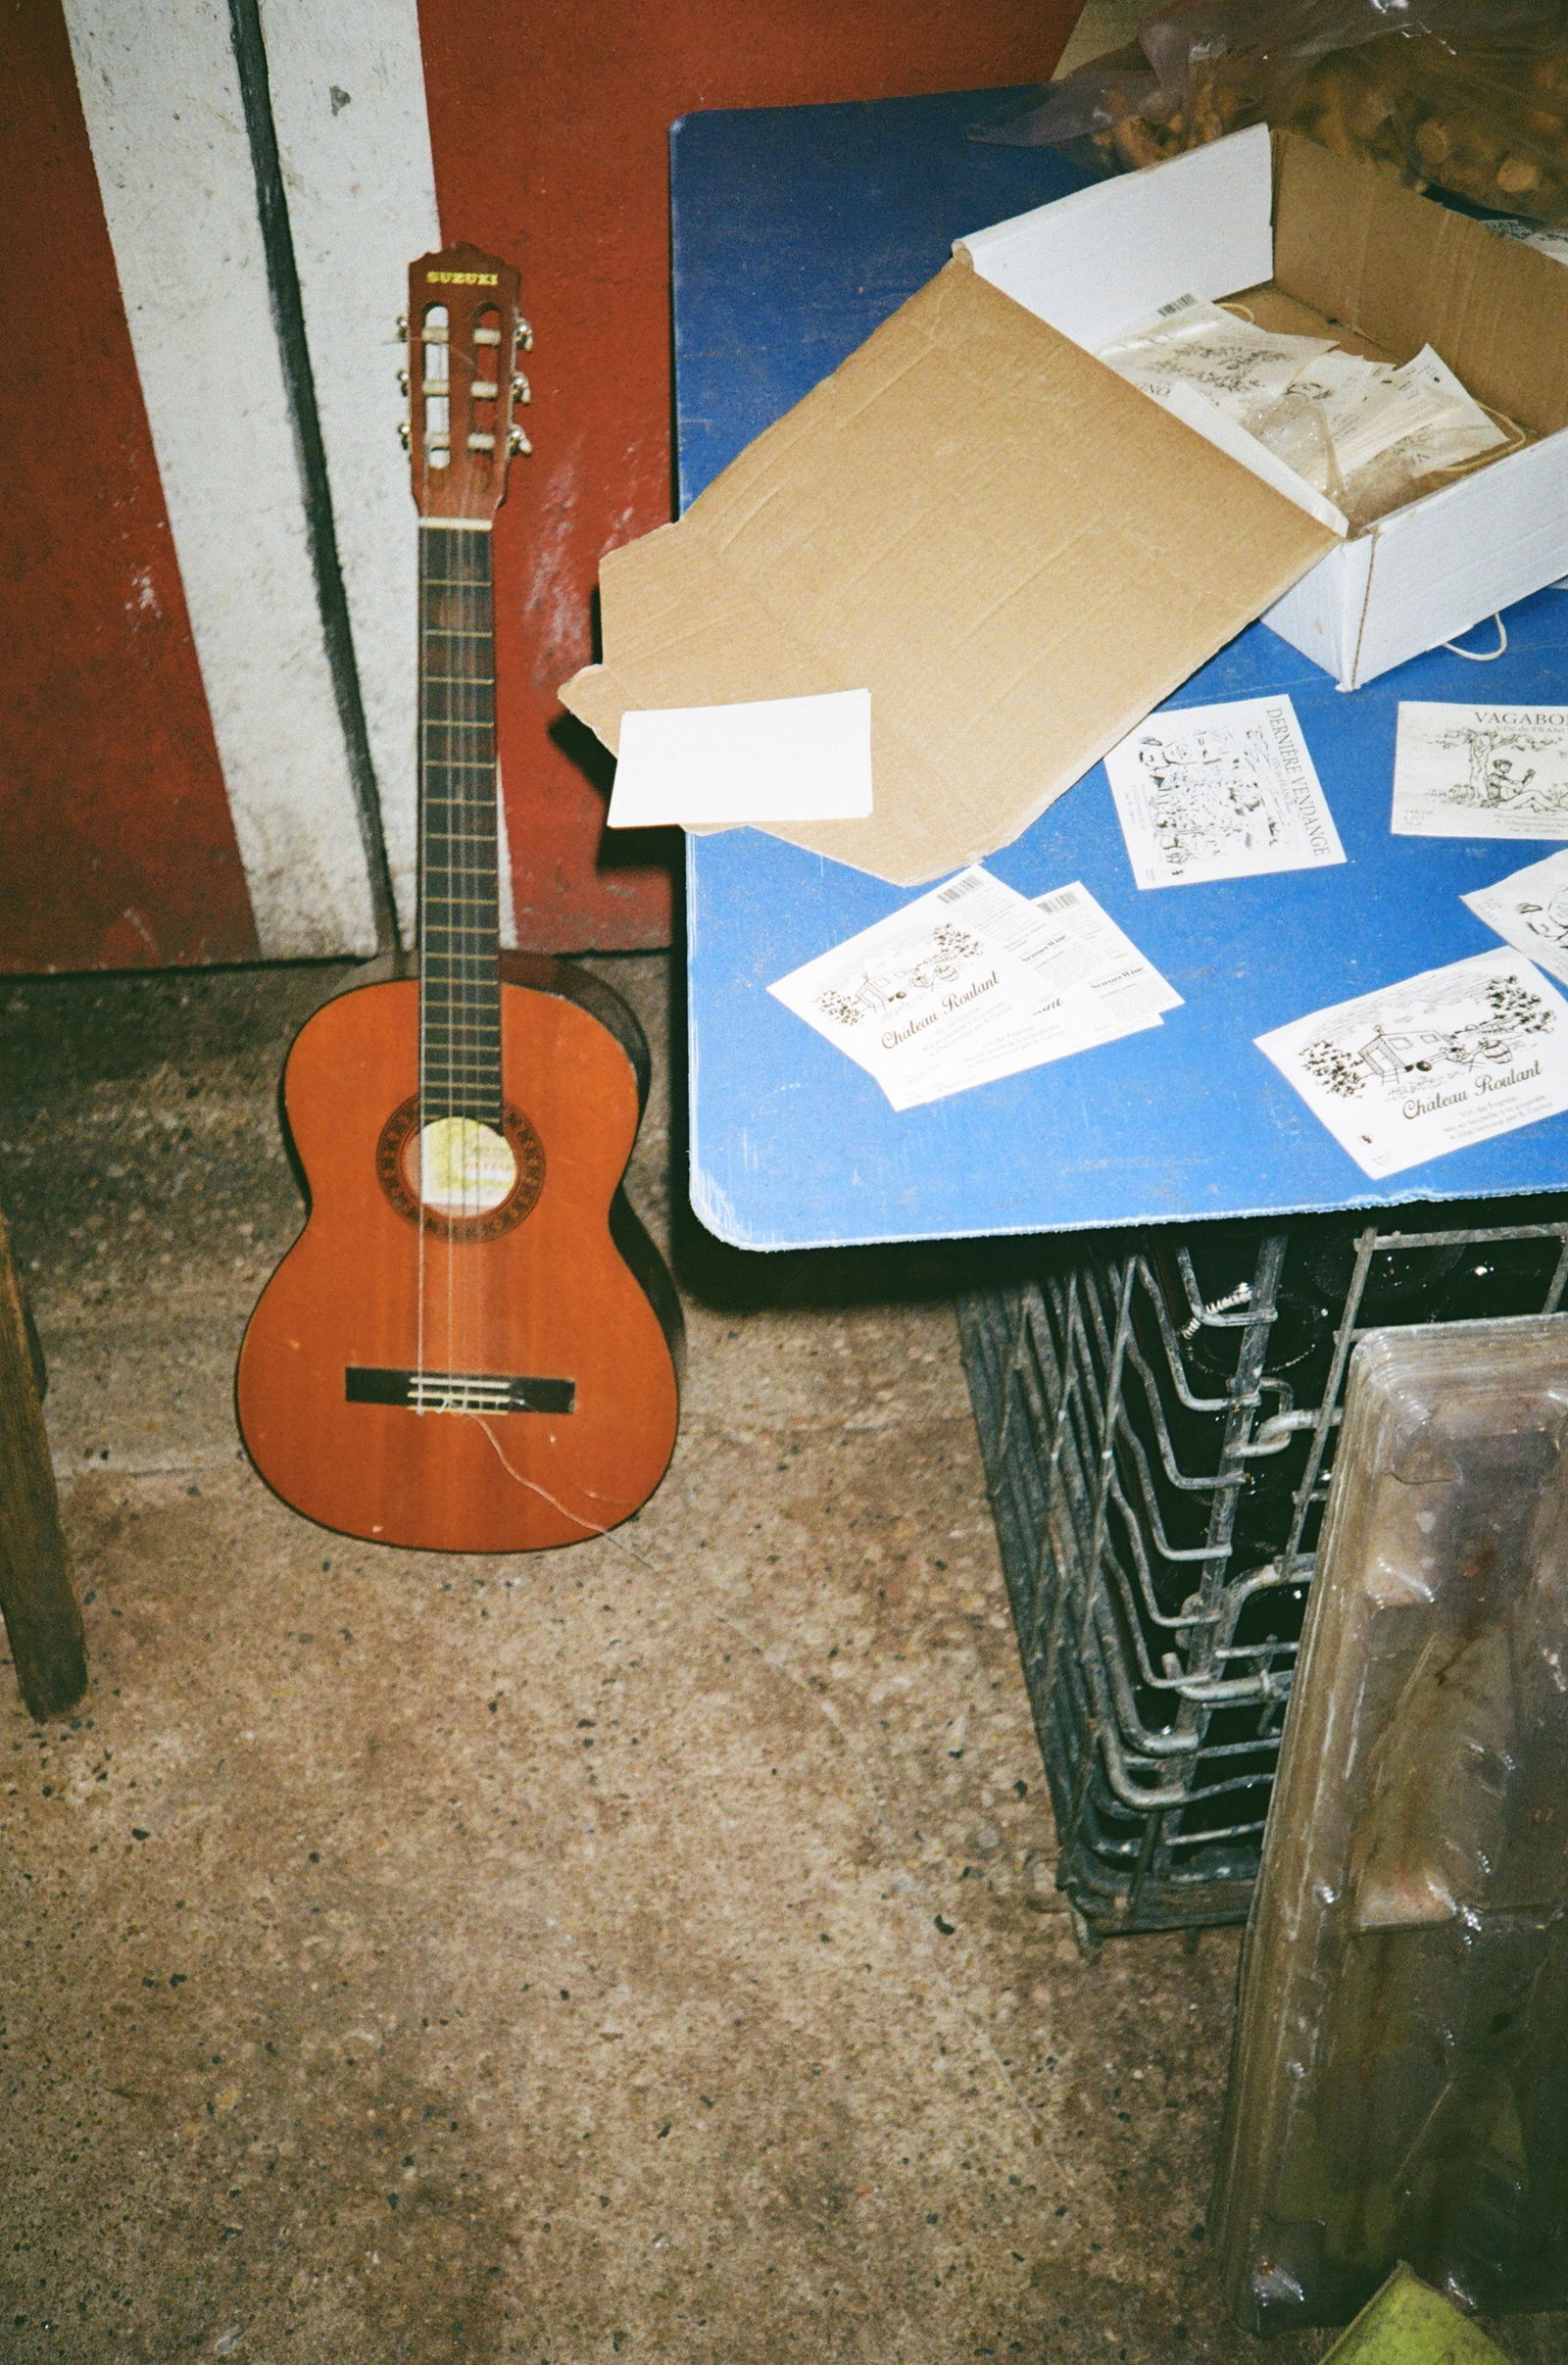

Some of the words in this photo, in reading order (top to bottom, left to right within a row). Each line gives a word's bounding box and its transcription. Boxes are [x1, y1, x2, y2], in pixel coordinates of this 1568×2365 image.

[426, 271, 499, 286] SUZUKI
[1474, 711, 1568, 725] VAGABO
[1266, 707, 1303, 775] DERNIÈRE
[1291, 775, 1332, 858] VENDANGE
[941, 969, 1002, 1015] Roulant
[1474, 1059, 1543, 1097] Roulant
